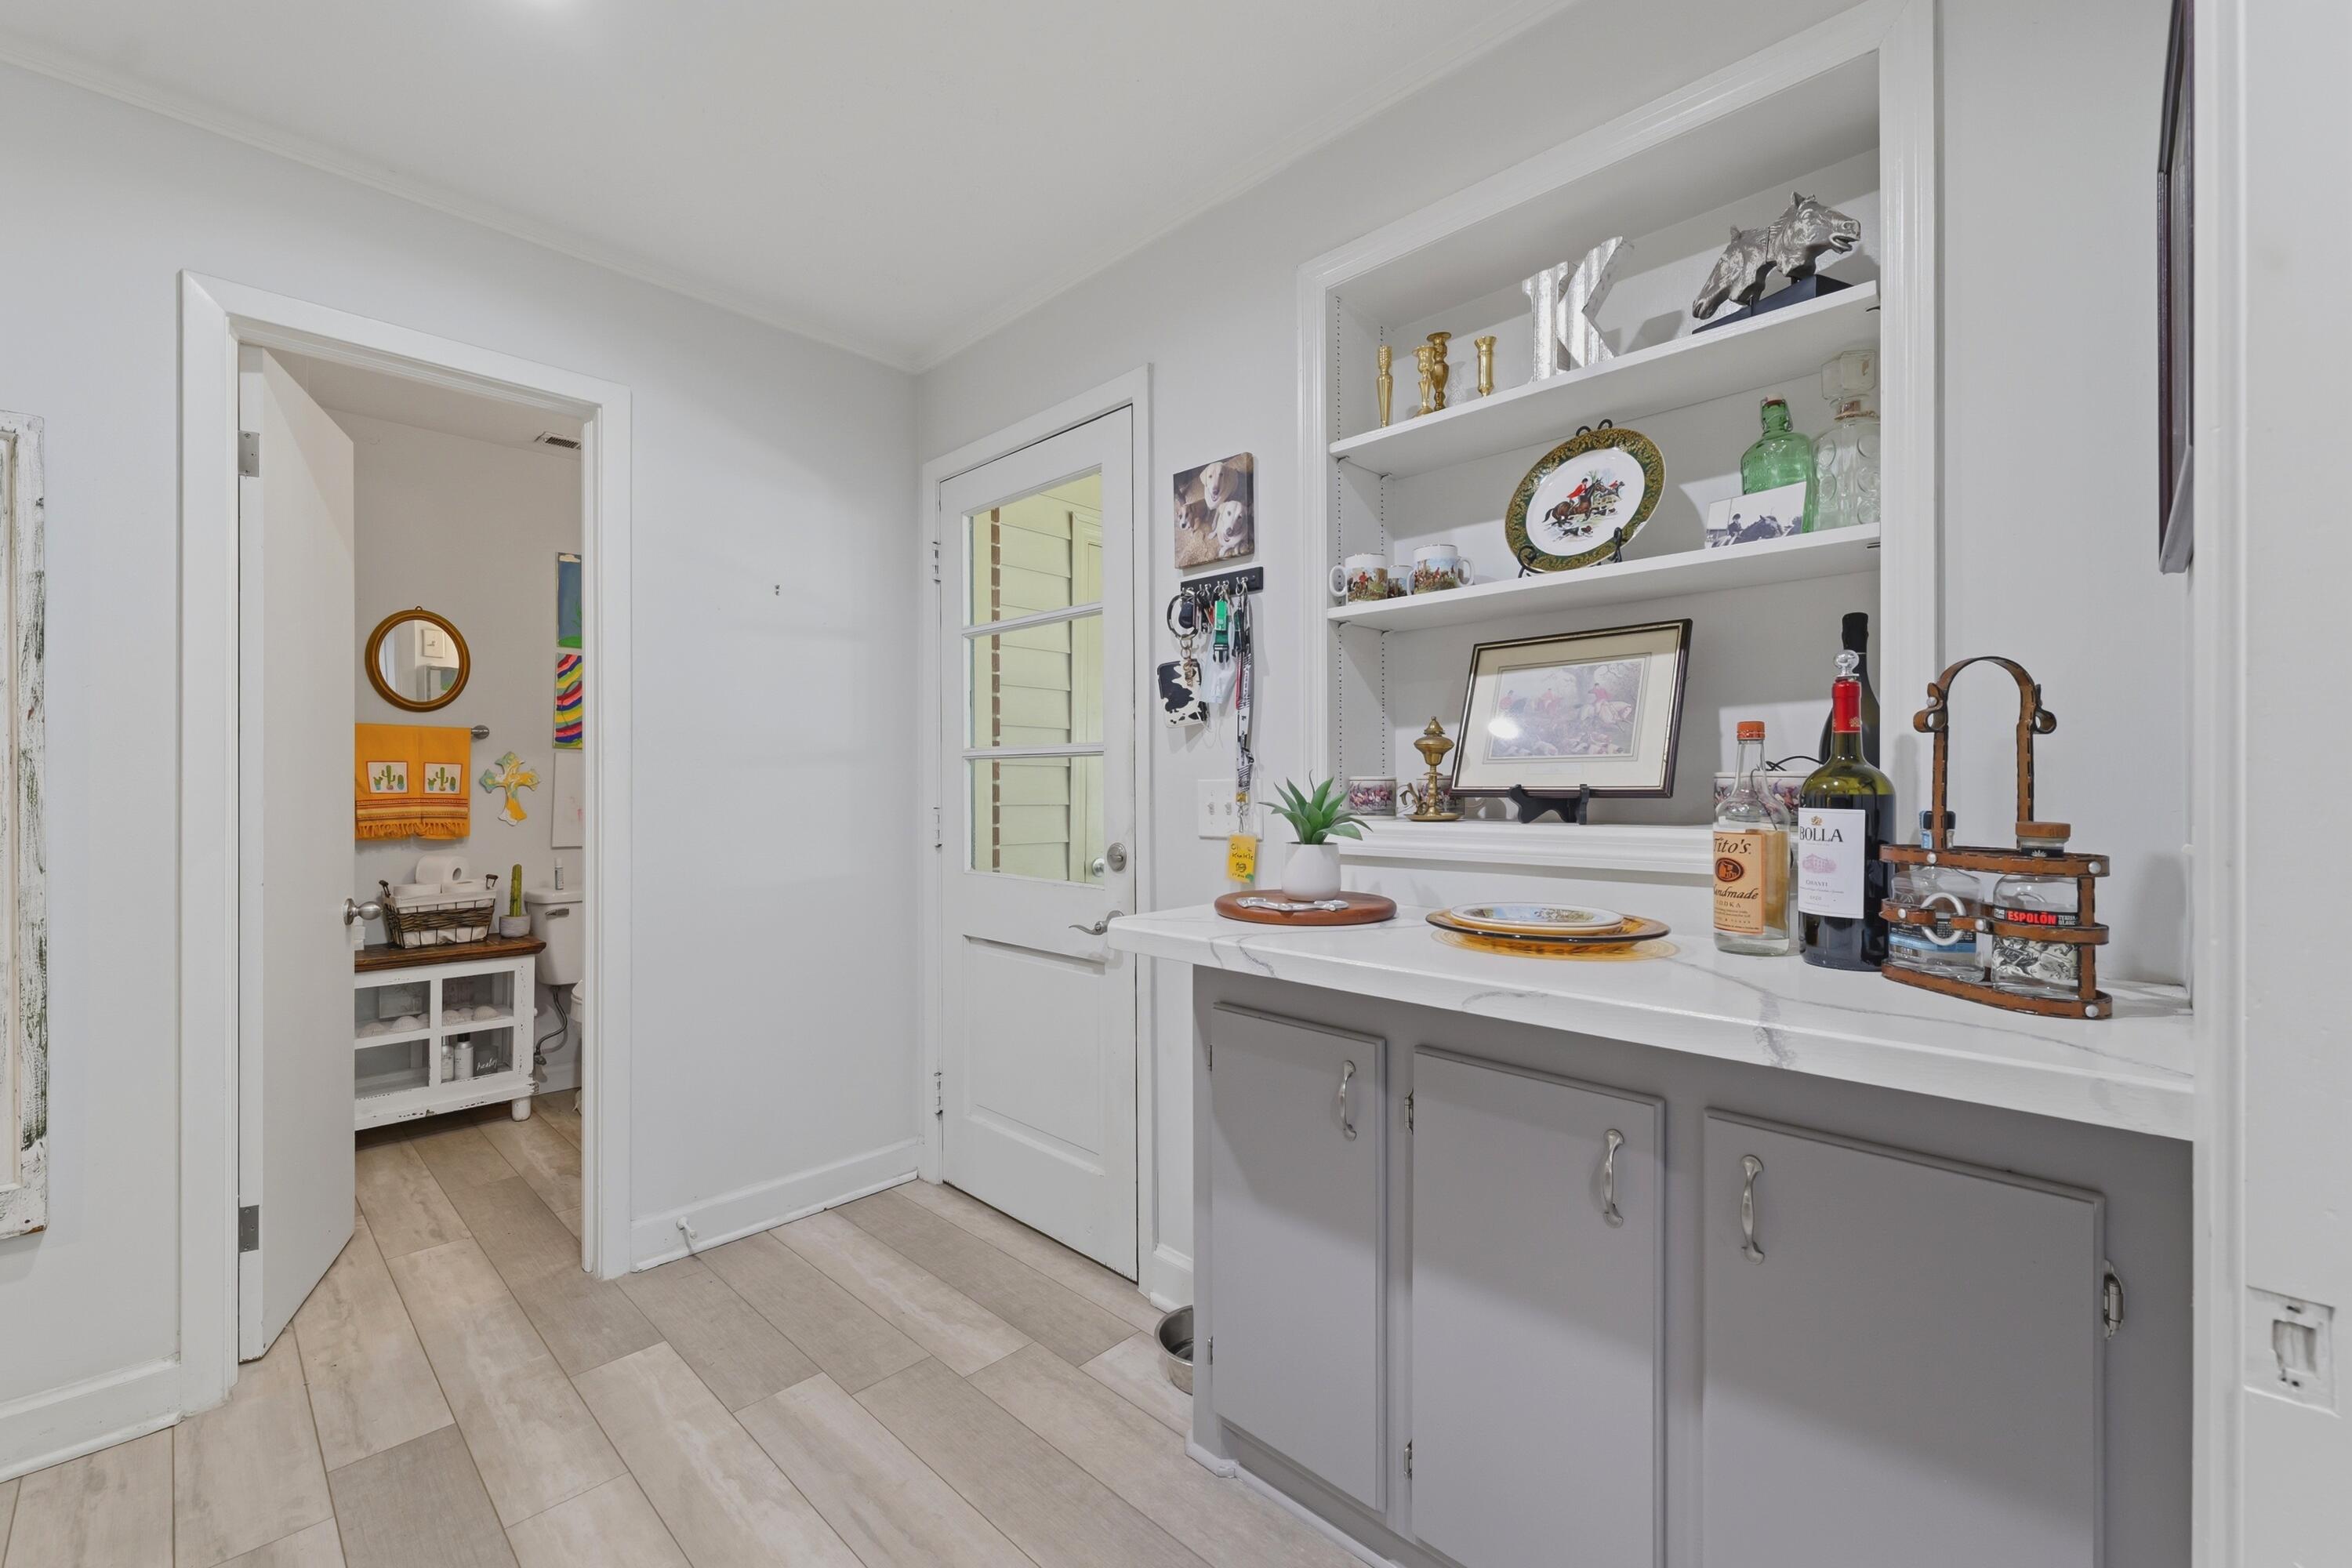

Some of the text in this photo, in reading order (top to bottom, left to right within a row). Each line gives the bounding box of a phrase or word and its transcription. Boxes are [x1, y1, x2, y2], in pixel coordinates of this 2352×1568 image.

[1522, 235, 1624, 383] K
[1799, 826, 1843, 843] BOLLA
[1714, 884, 1759, 900] andmade
